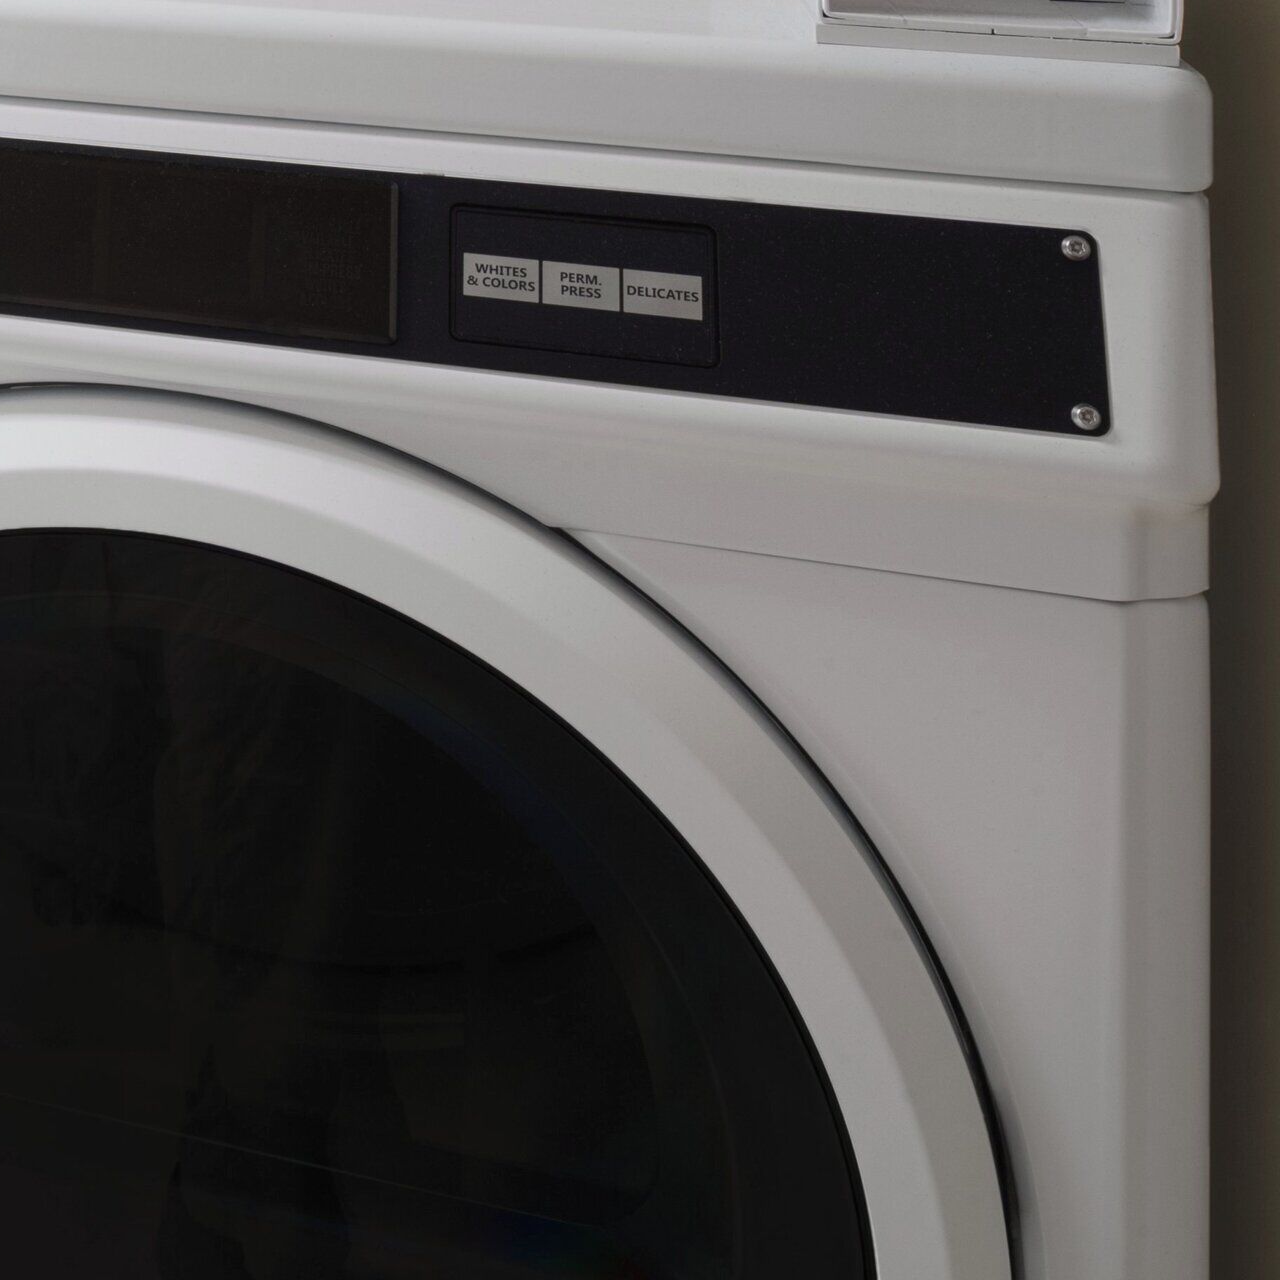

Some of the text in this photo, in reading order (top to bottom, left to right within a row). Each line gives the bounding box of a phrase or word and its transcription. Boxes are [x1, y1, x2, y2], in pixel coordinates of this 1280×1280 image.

[475, 262, 528, 278] WHITES
[466, 275, 536, 292] & COLORS
[560, 271, 602, 286] PERM.
[561, 284, 602, 299] PRESS
[627, 285, 700, 303] DELICATES
